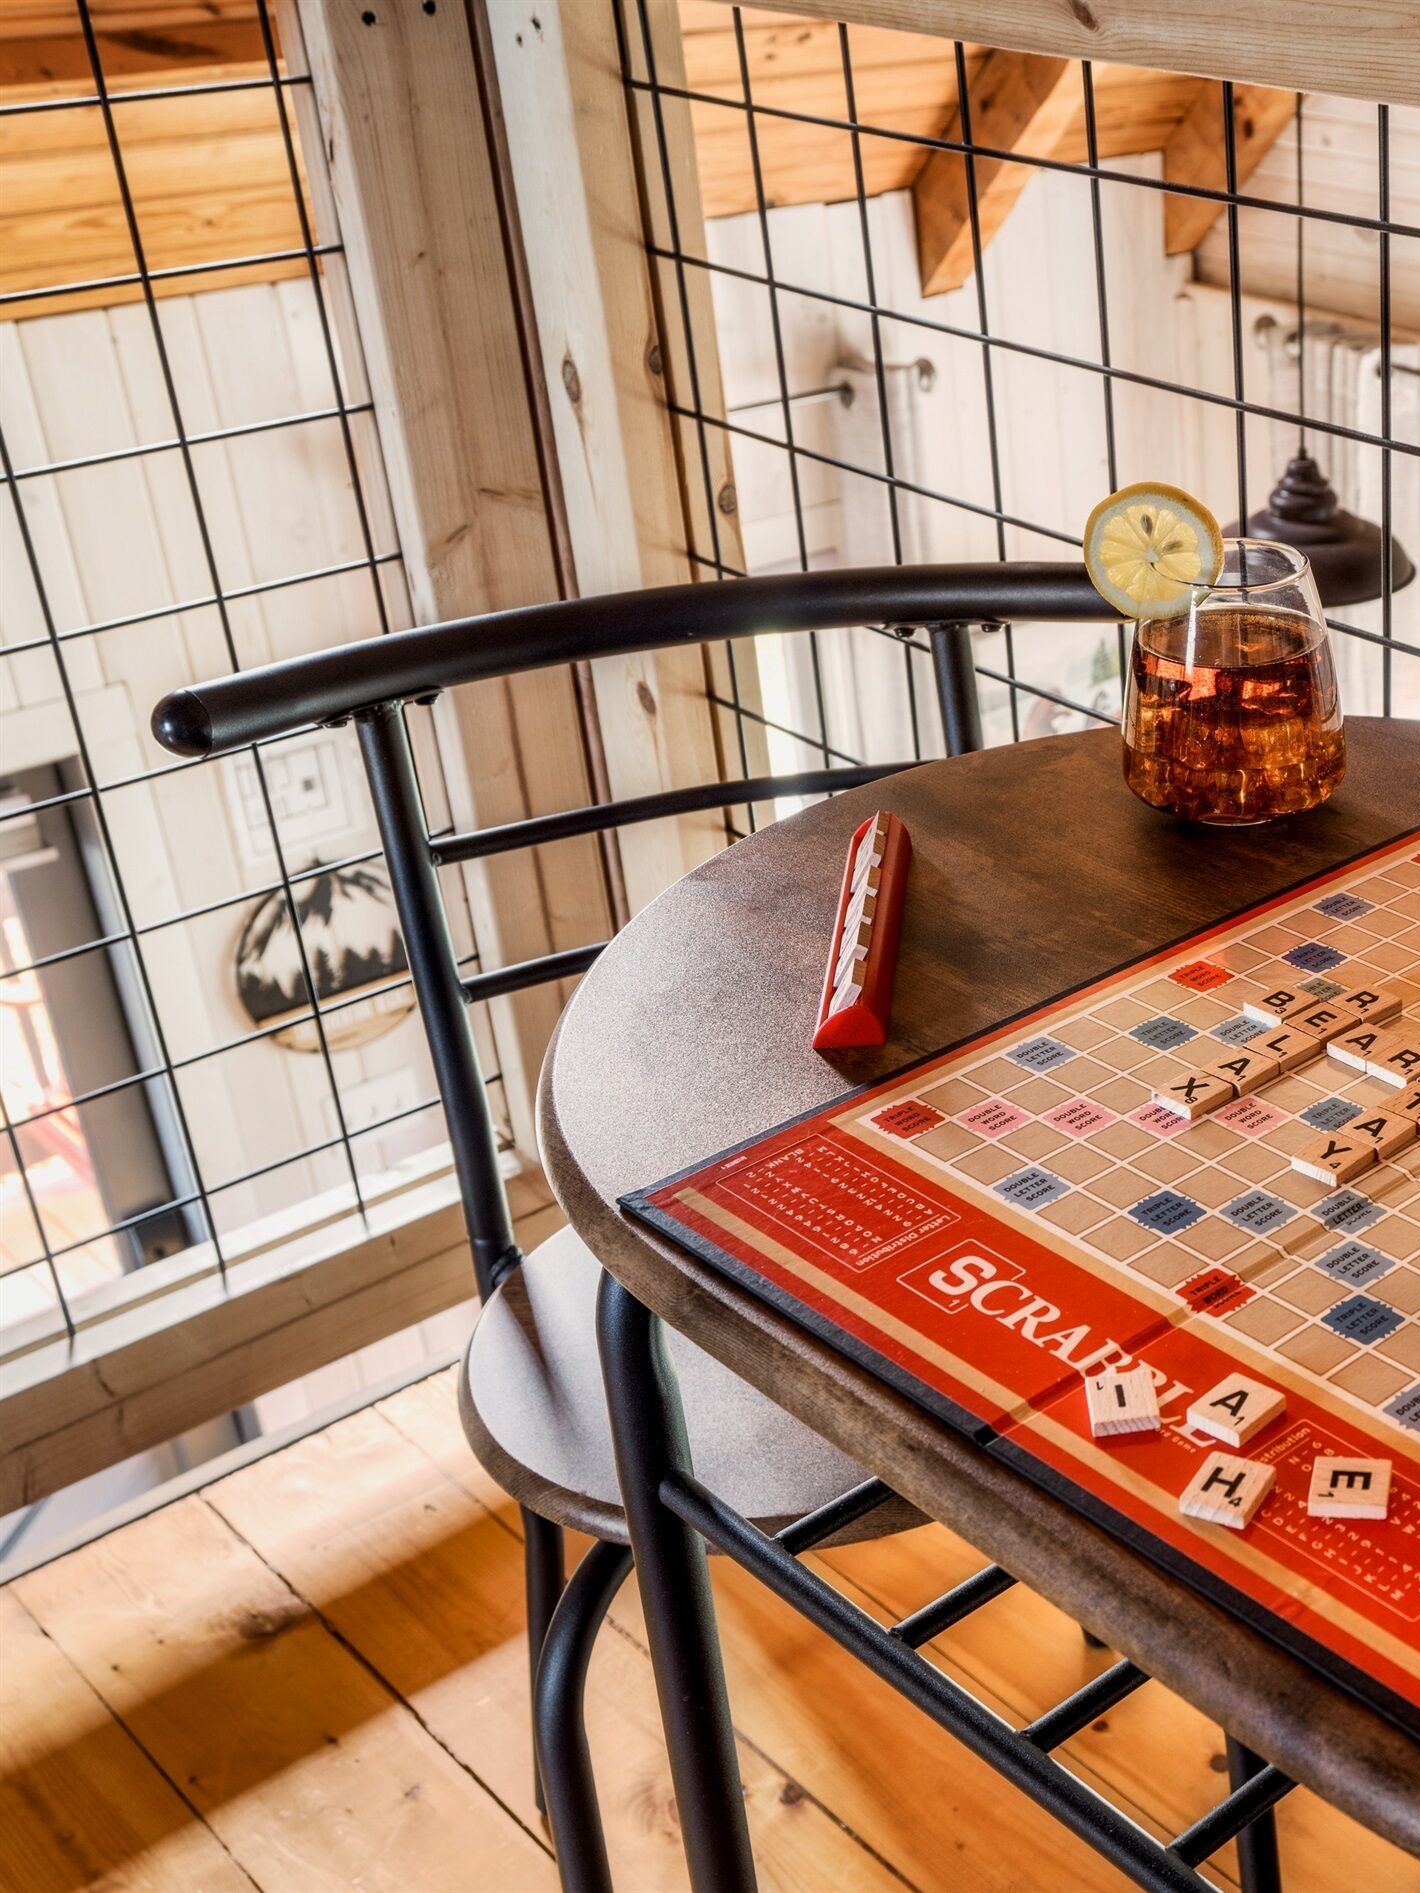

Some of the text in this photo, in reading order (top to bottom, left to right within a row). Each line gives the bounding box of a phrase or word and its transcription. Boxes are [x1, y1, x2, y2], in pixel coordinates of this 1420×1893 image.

[1017, 1041, 1049, 1058] DOUBLE
[1026, 1046, 1057, 1062] LETTER
[1036, 1051, 1063, 1065] SCORE
[968, 1104, 1002, 1122] DOUBLE
[981, 1111, 1007, 1125] WORD
[988, 1115, 1017, 1130] SCORE
[1005, 1173, 1040, 1192] DOUBLE
[1015, 1178, 1049, 1197] LETTER
[1026, 1185, 1056, 1201] SCORE
[856, 1216, 951, 1267] Letter Distribution
